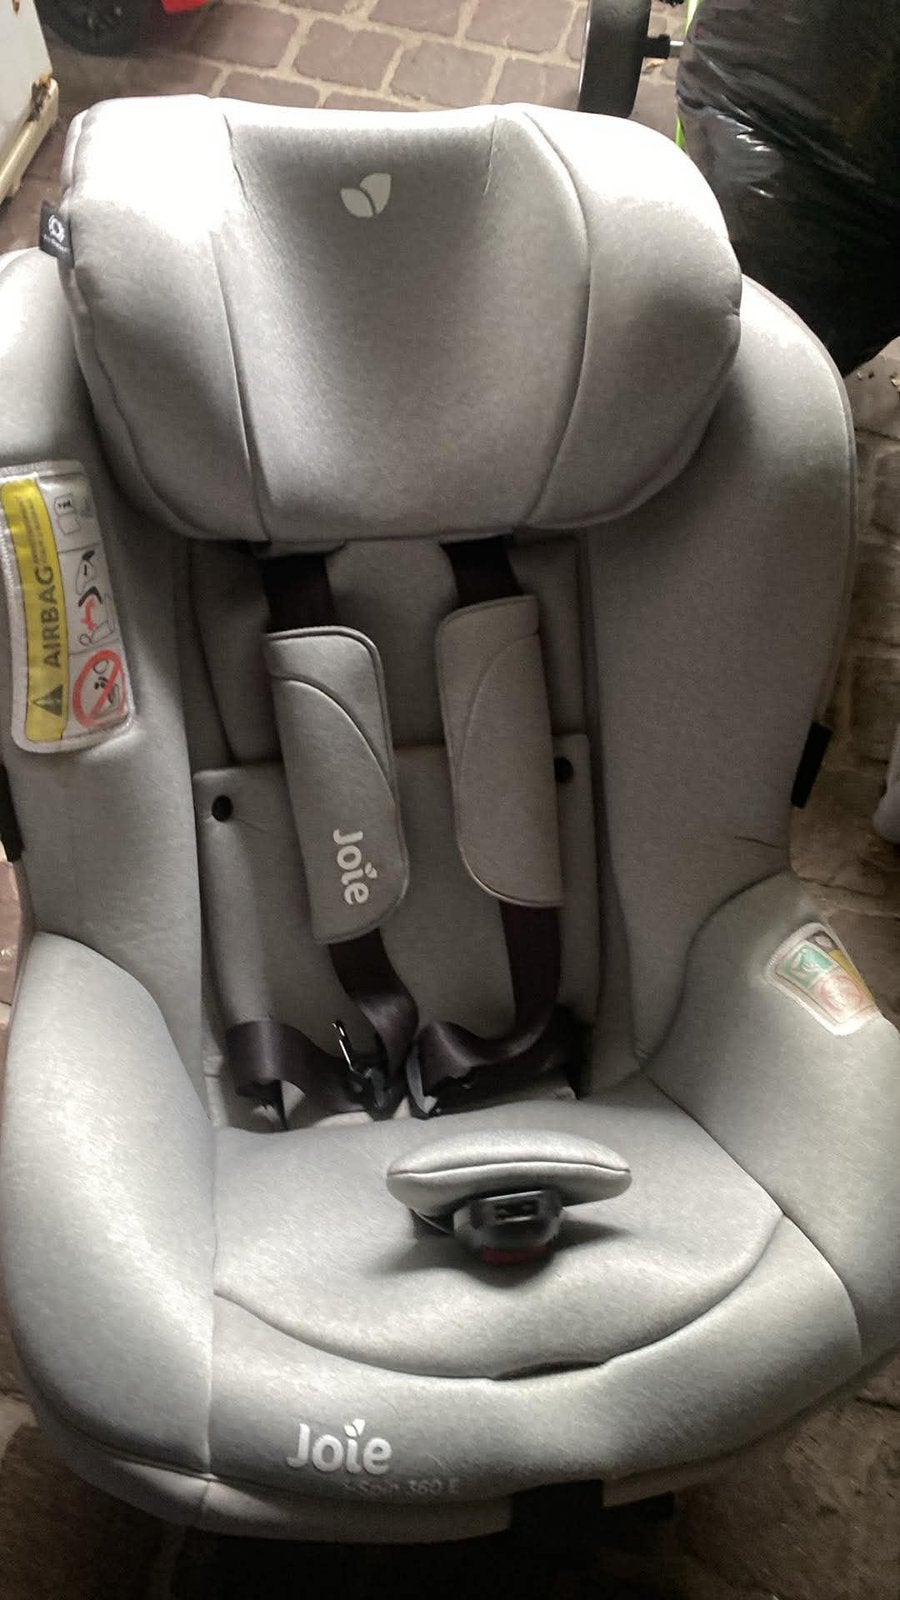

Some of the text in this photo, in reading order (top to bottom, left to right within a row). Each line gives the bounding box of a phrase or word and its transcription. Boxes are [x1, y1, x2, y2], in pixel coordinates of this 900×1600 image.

[35, 565, 61, 668] AIRBAG
[333, 829, 377, 905] Joie
[286, 1418, 393, 1475] Joie
[408, 1479, 443, 1496] 360
